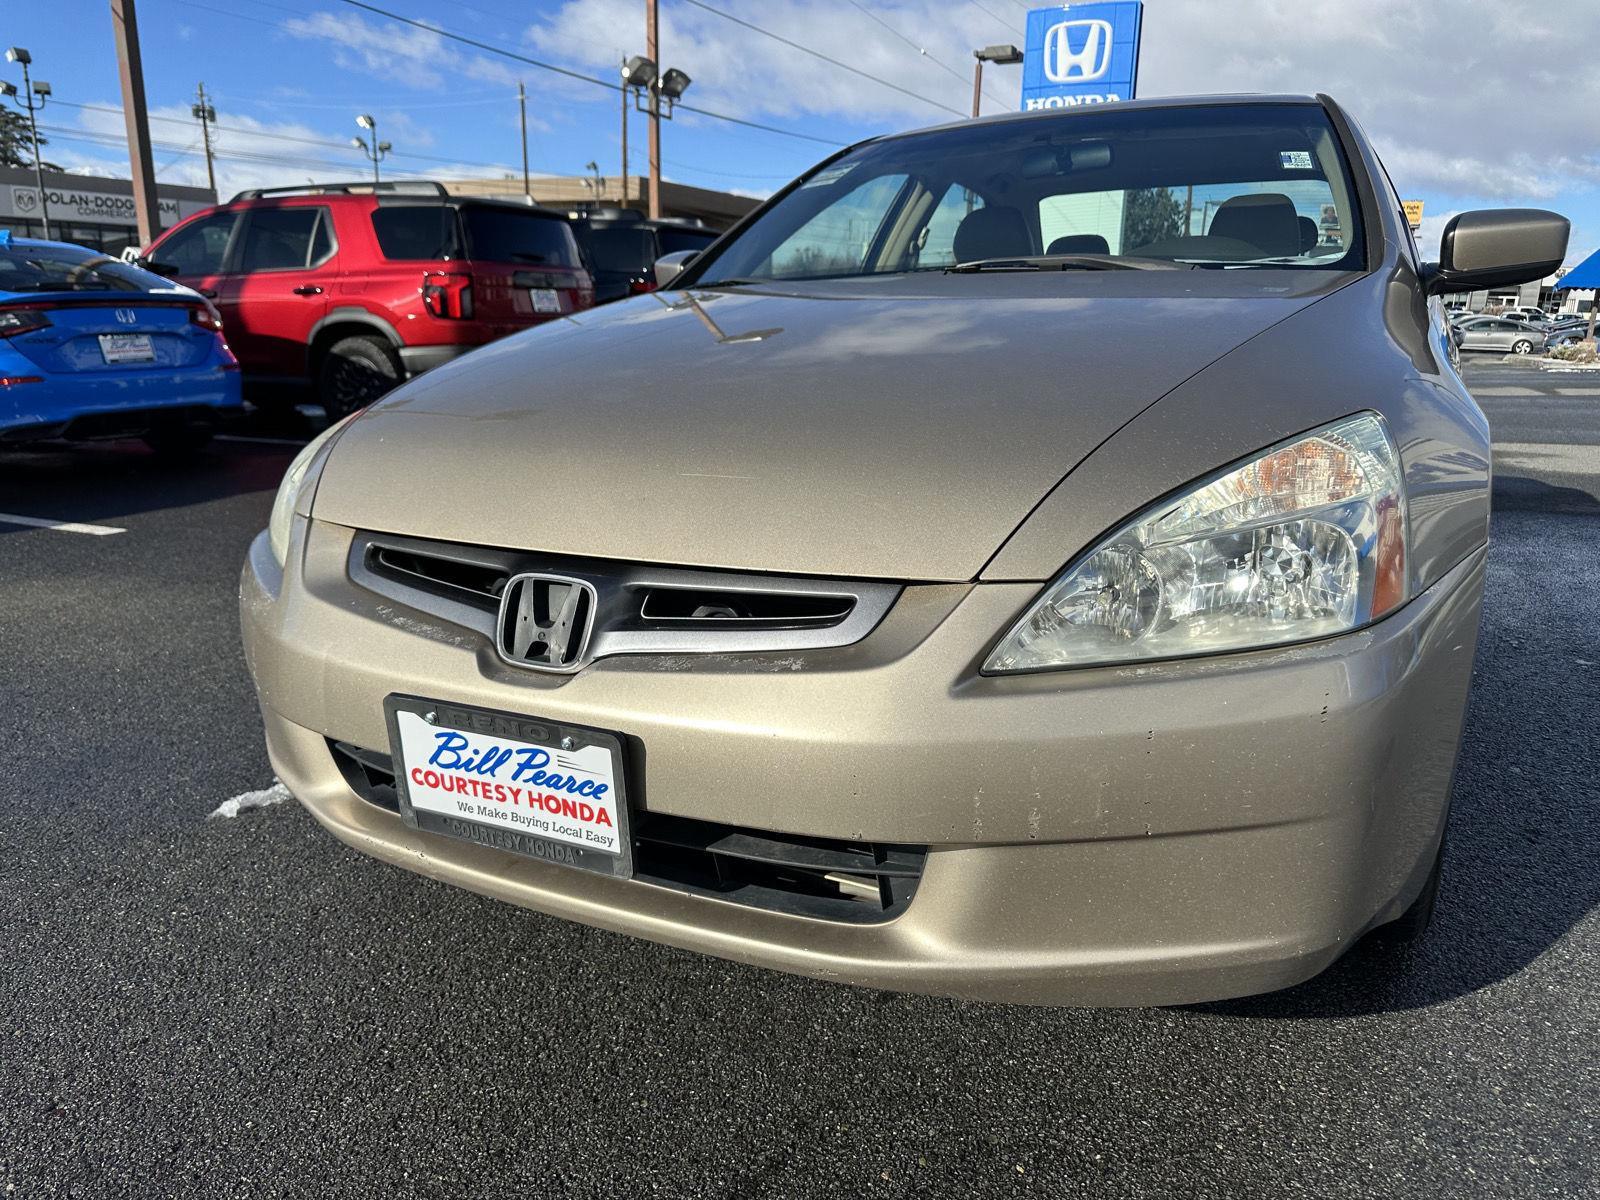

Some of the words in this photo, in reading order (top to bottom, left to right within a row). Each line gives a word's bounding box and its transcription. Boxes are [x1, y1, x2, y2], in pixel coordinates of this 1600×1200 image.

[1026, 93, 1120, 111] HONDA
[39, 191, 135, 209] DOLAN-DODG
[446, 709, 551, 741] RENO
[428, 731, 513, 778] Bill
[511, 748, 609, 800] Pearce
[411, 767, 522, 805] COURTESY
[528, 790, 613, 828] HONDA
[452, 822, 521, 850] COURTESY
[526, 838, 577, 864] HONDA
[456, 801, 474, 814] We
[477, 805, 508, 821] Make
[511, 811, 550, 832] Buying
[552, 821, 582, 839] Local
[585, 830, 615, 848] Easy
